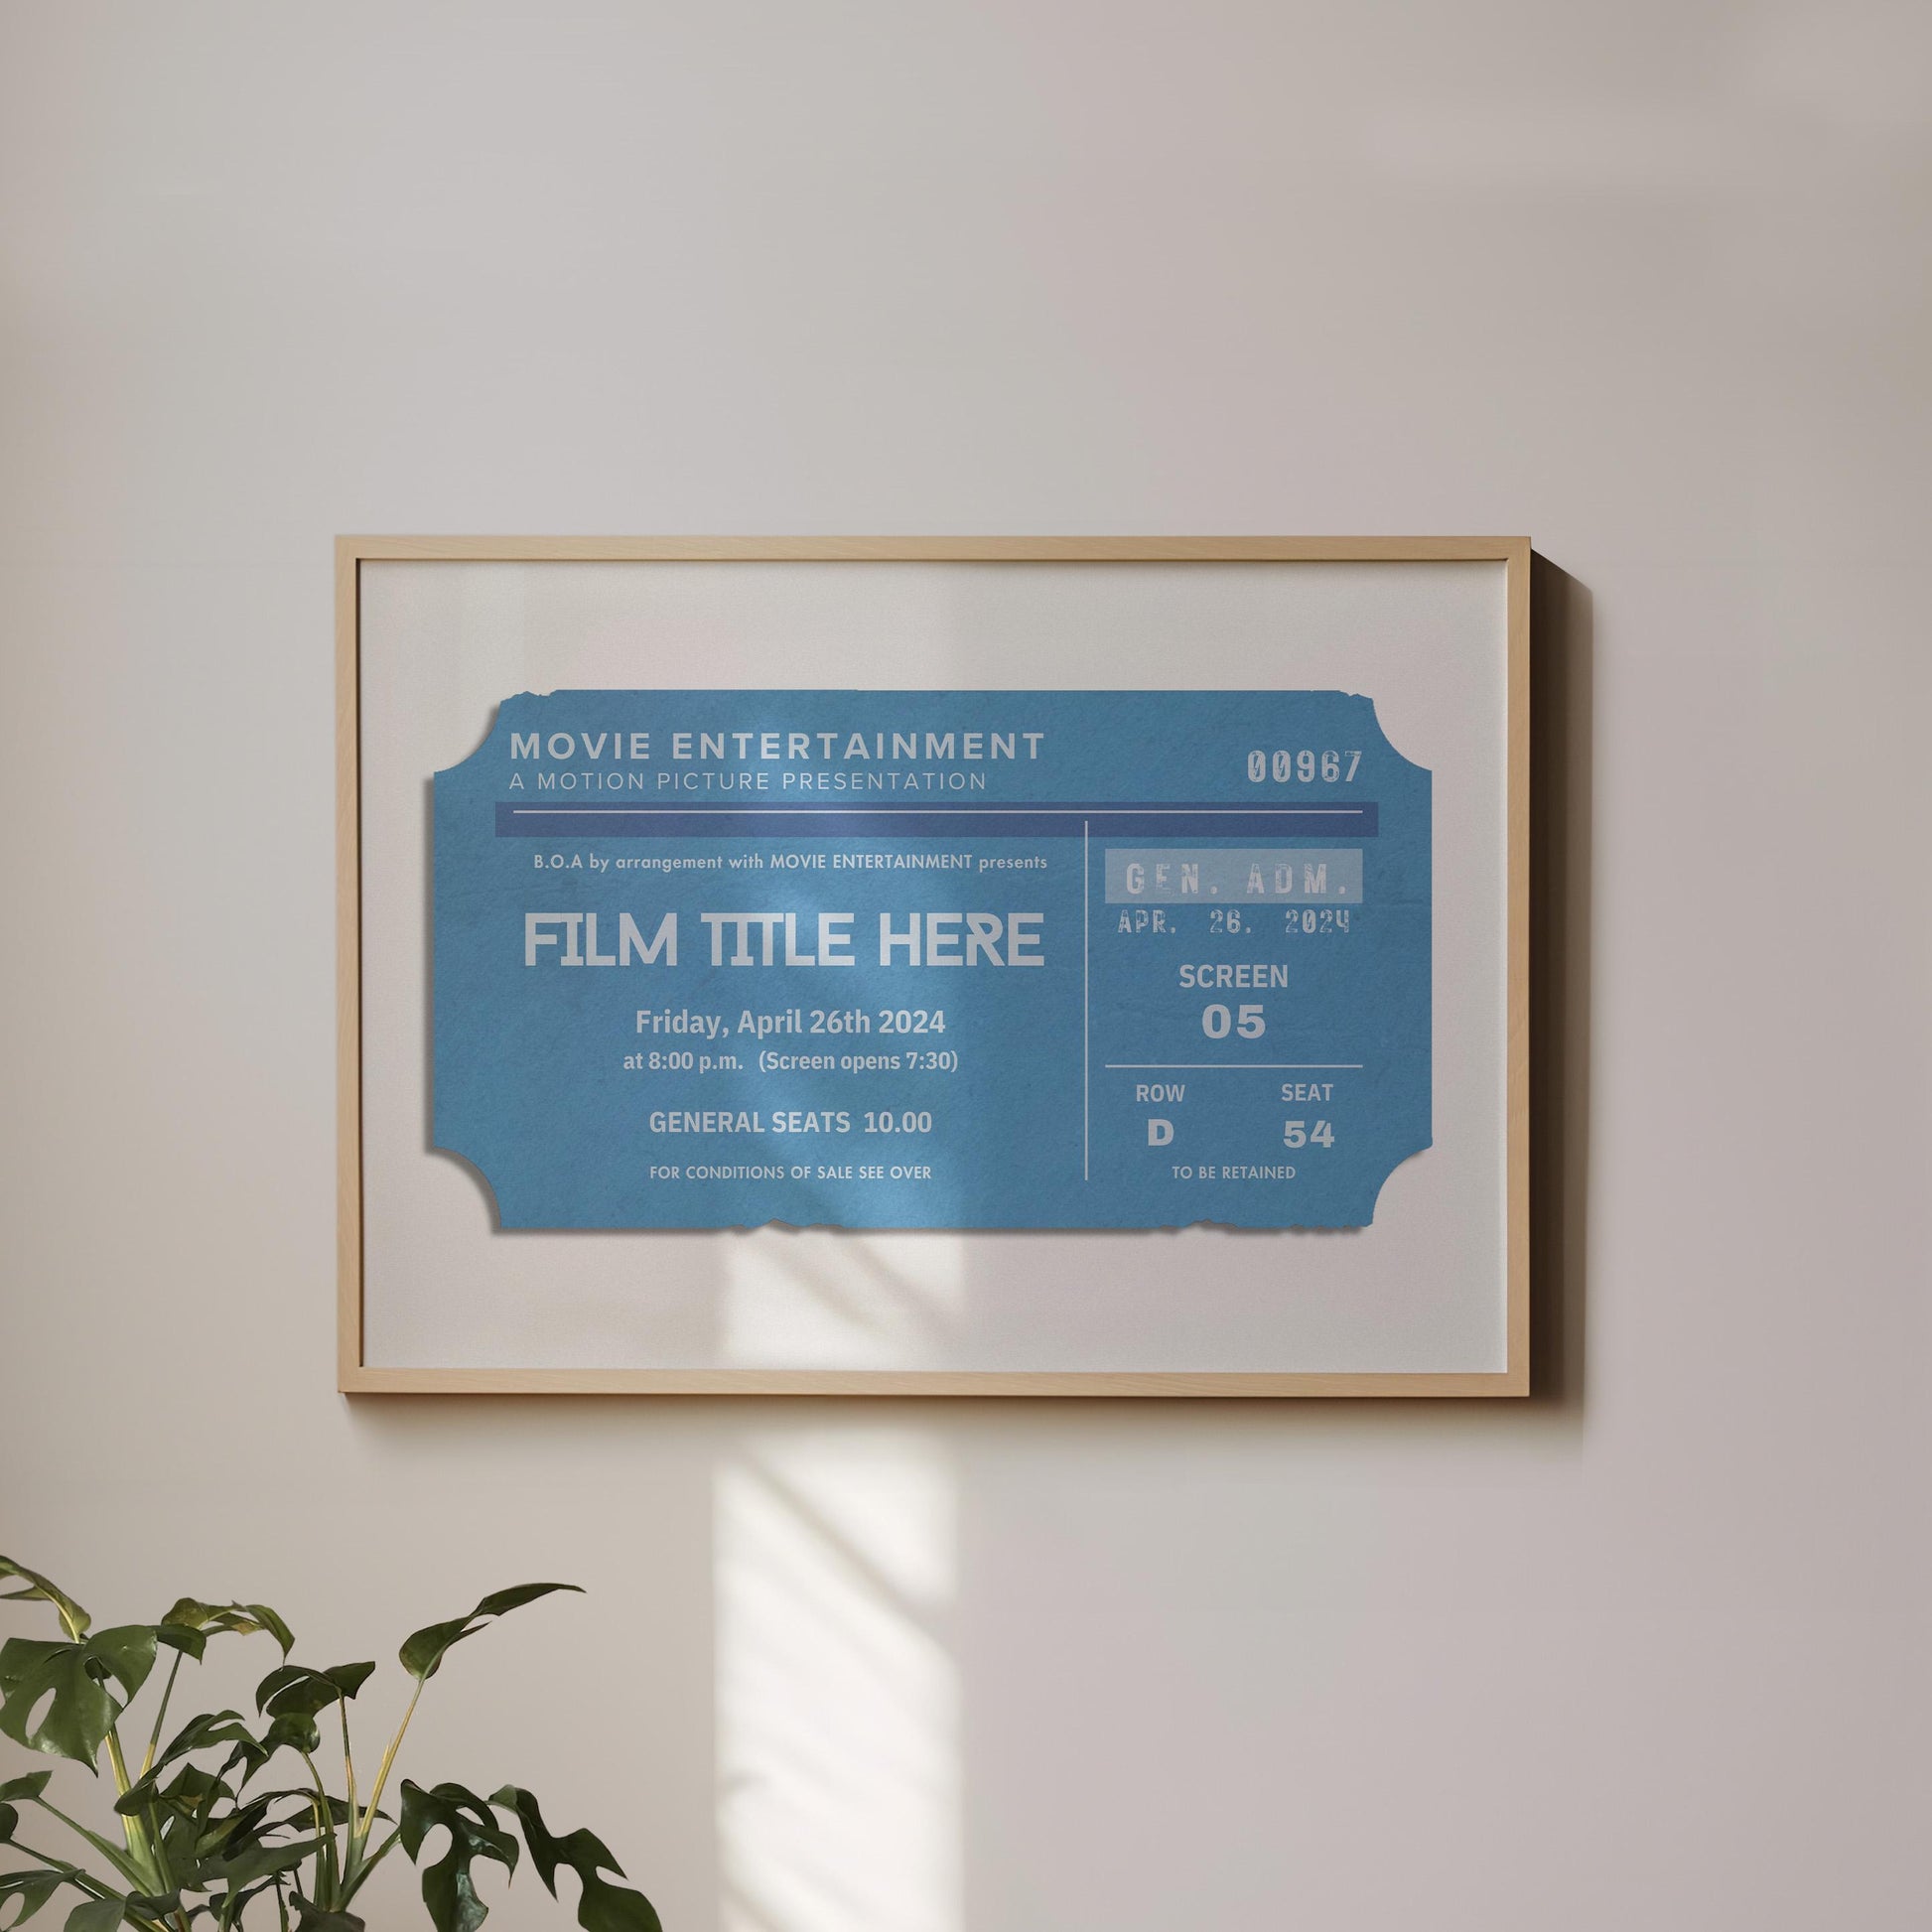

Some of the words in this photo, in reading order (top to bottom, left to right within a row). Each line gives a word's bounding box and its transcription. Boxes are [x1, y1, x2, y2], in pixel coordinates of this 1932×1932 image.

[511, 733, 649, 759] MOVIE
[673, 733, 1043, 759] ENTERTAINMENT
[1248, 751, 1361, 782] 00967
[509, 773, 524, 789] A
[538, 773, 642, 789] MOTION
[658, 772, 768, 789] PICTURE
[783, 772, 984, 789] PRESENTATION
[535, 855, 583, 868] B.O.A
[590, 853, 609, 873] by
[617, 857, 723, 873] arrangement
[729, 853, 762, 868] with
[770, 855, 825, 868] MOVIE
[834, 854, 972, 869] ENTERTAINMENT
[980, 857, 1046, 873] presents
[1127, 864, 1217, 894] GEN.
[1247, 864, 1345, 894] ADM.
[1118, 909, 1175, 933] APR.
[1210, 909, 1250, 933] 26.
[1286, 909, 1348, 933] 2024
[525, 913, 677, 966] FILM
[701, 912, 855, 966] TITLE
[880, 913, 1043, 966] HERE
[1179, 965, 1288, 988] SCREEN
[637, 1009, 729, 1039] Friday,
[738, 1009, 802, 1039] April
[810, 1009, 870, 1034] 26th
[880, 1010, 945, 1033] 2024
[1202, 1005, 1265, 1038] 05
[623, 1053, 642, 1069] at
[649, 1052, 693, 1069] 8:00
[700, 1056, 743, 1073] p.m.
[759, 1050, 834, 1072] (Screen
[841, 1056, 900, 1073] opens
[906, 1050, 957, 1072] 7:30)
[1137, 1084, 1184, 1102] ROW
[1282, 1084, 1333, 1101] SEAT
[650, 1112, 764, 1132] GENERAL
[772, 1112, 850, 1133] SEATS
[865, 1112, 931, 1133] 10.00
[1149, 1119, 1173, 1146] D
[1284, 1121, 1334, 1148] 54
[650, 1167, 679, 1178] FOR
[686, 1167, 784, 1178] CONDITIONS
[791, 1167, 810, 1178] OF
[818, 1167, 852, 1178] SALE
[860, 1167, 884, 1178] SEE
[891, 1167, 930, 1178] OVER
[1173, 1167, 1192, 1178] TO
[1199, 1167, 1215, 1178] BE
[1223, 1167, 1296, 1178] RETAINED
